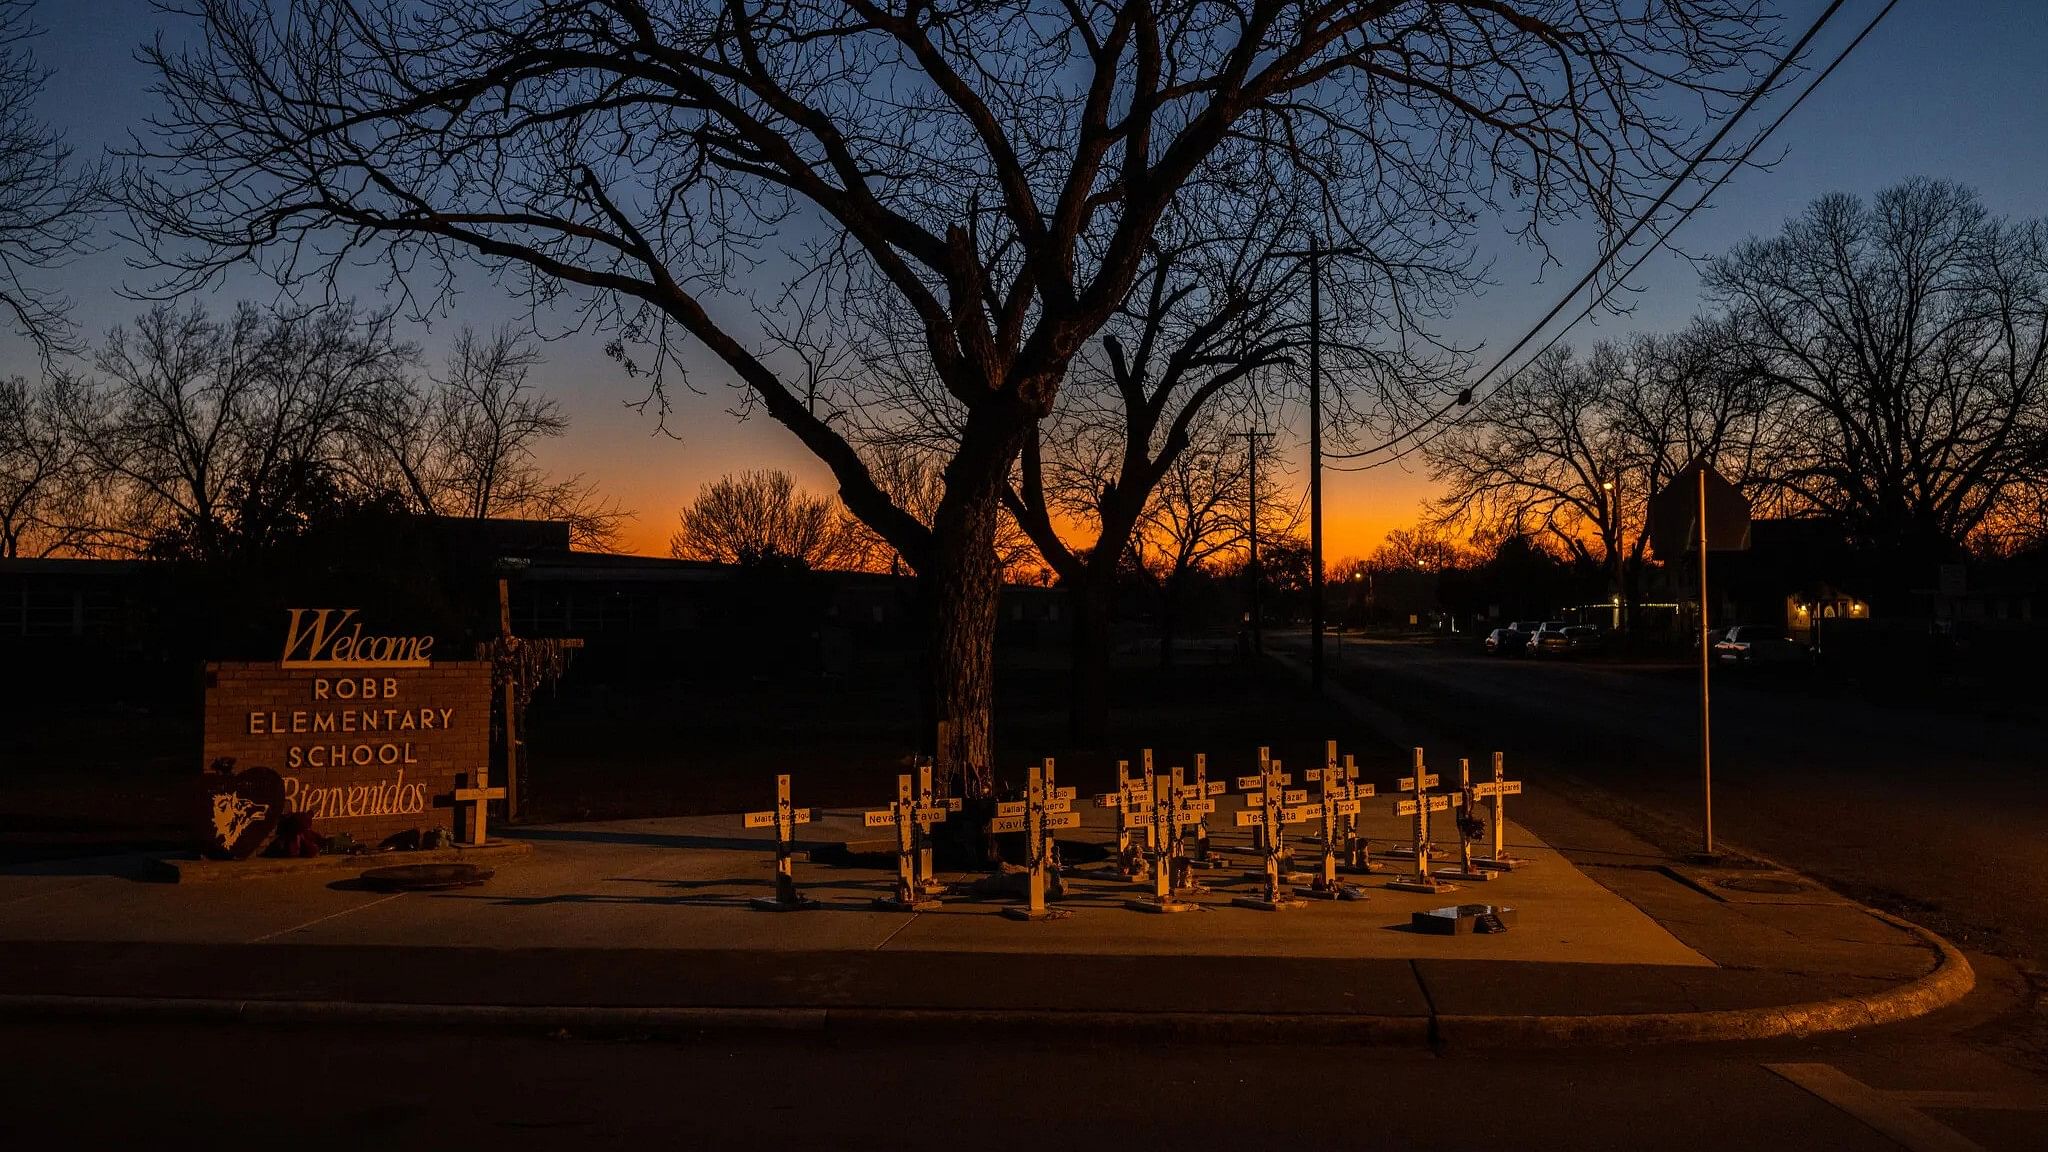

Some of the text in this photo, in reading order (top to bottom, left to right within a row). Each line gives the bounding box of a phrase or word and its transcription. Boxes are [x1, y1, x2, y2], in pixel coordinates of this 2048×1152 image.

[283, 608, 434, 662] Welcome
[314, 678, 398, 700] ROBB
[249, 708, 453, 734] ELEMENTARY
[288, 743, 418, 768] SCHOOL
[281, 768, 428, 818] Bienvenidos
